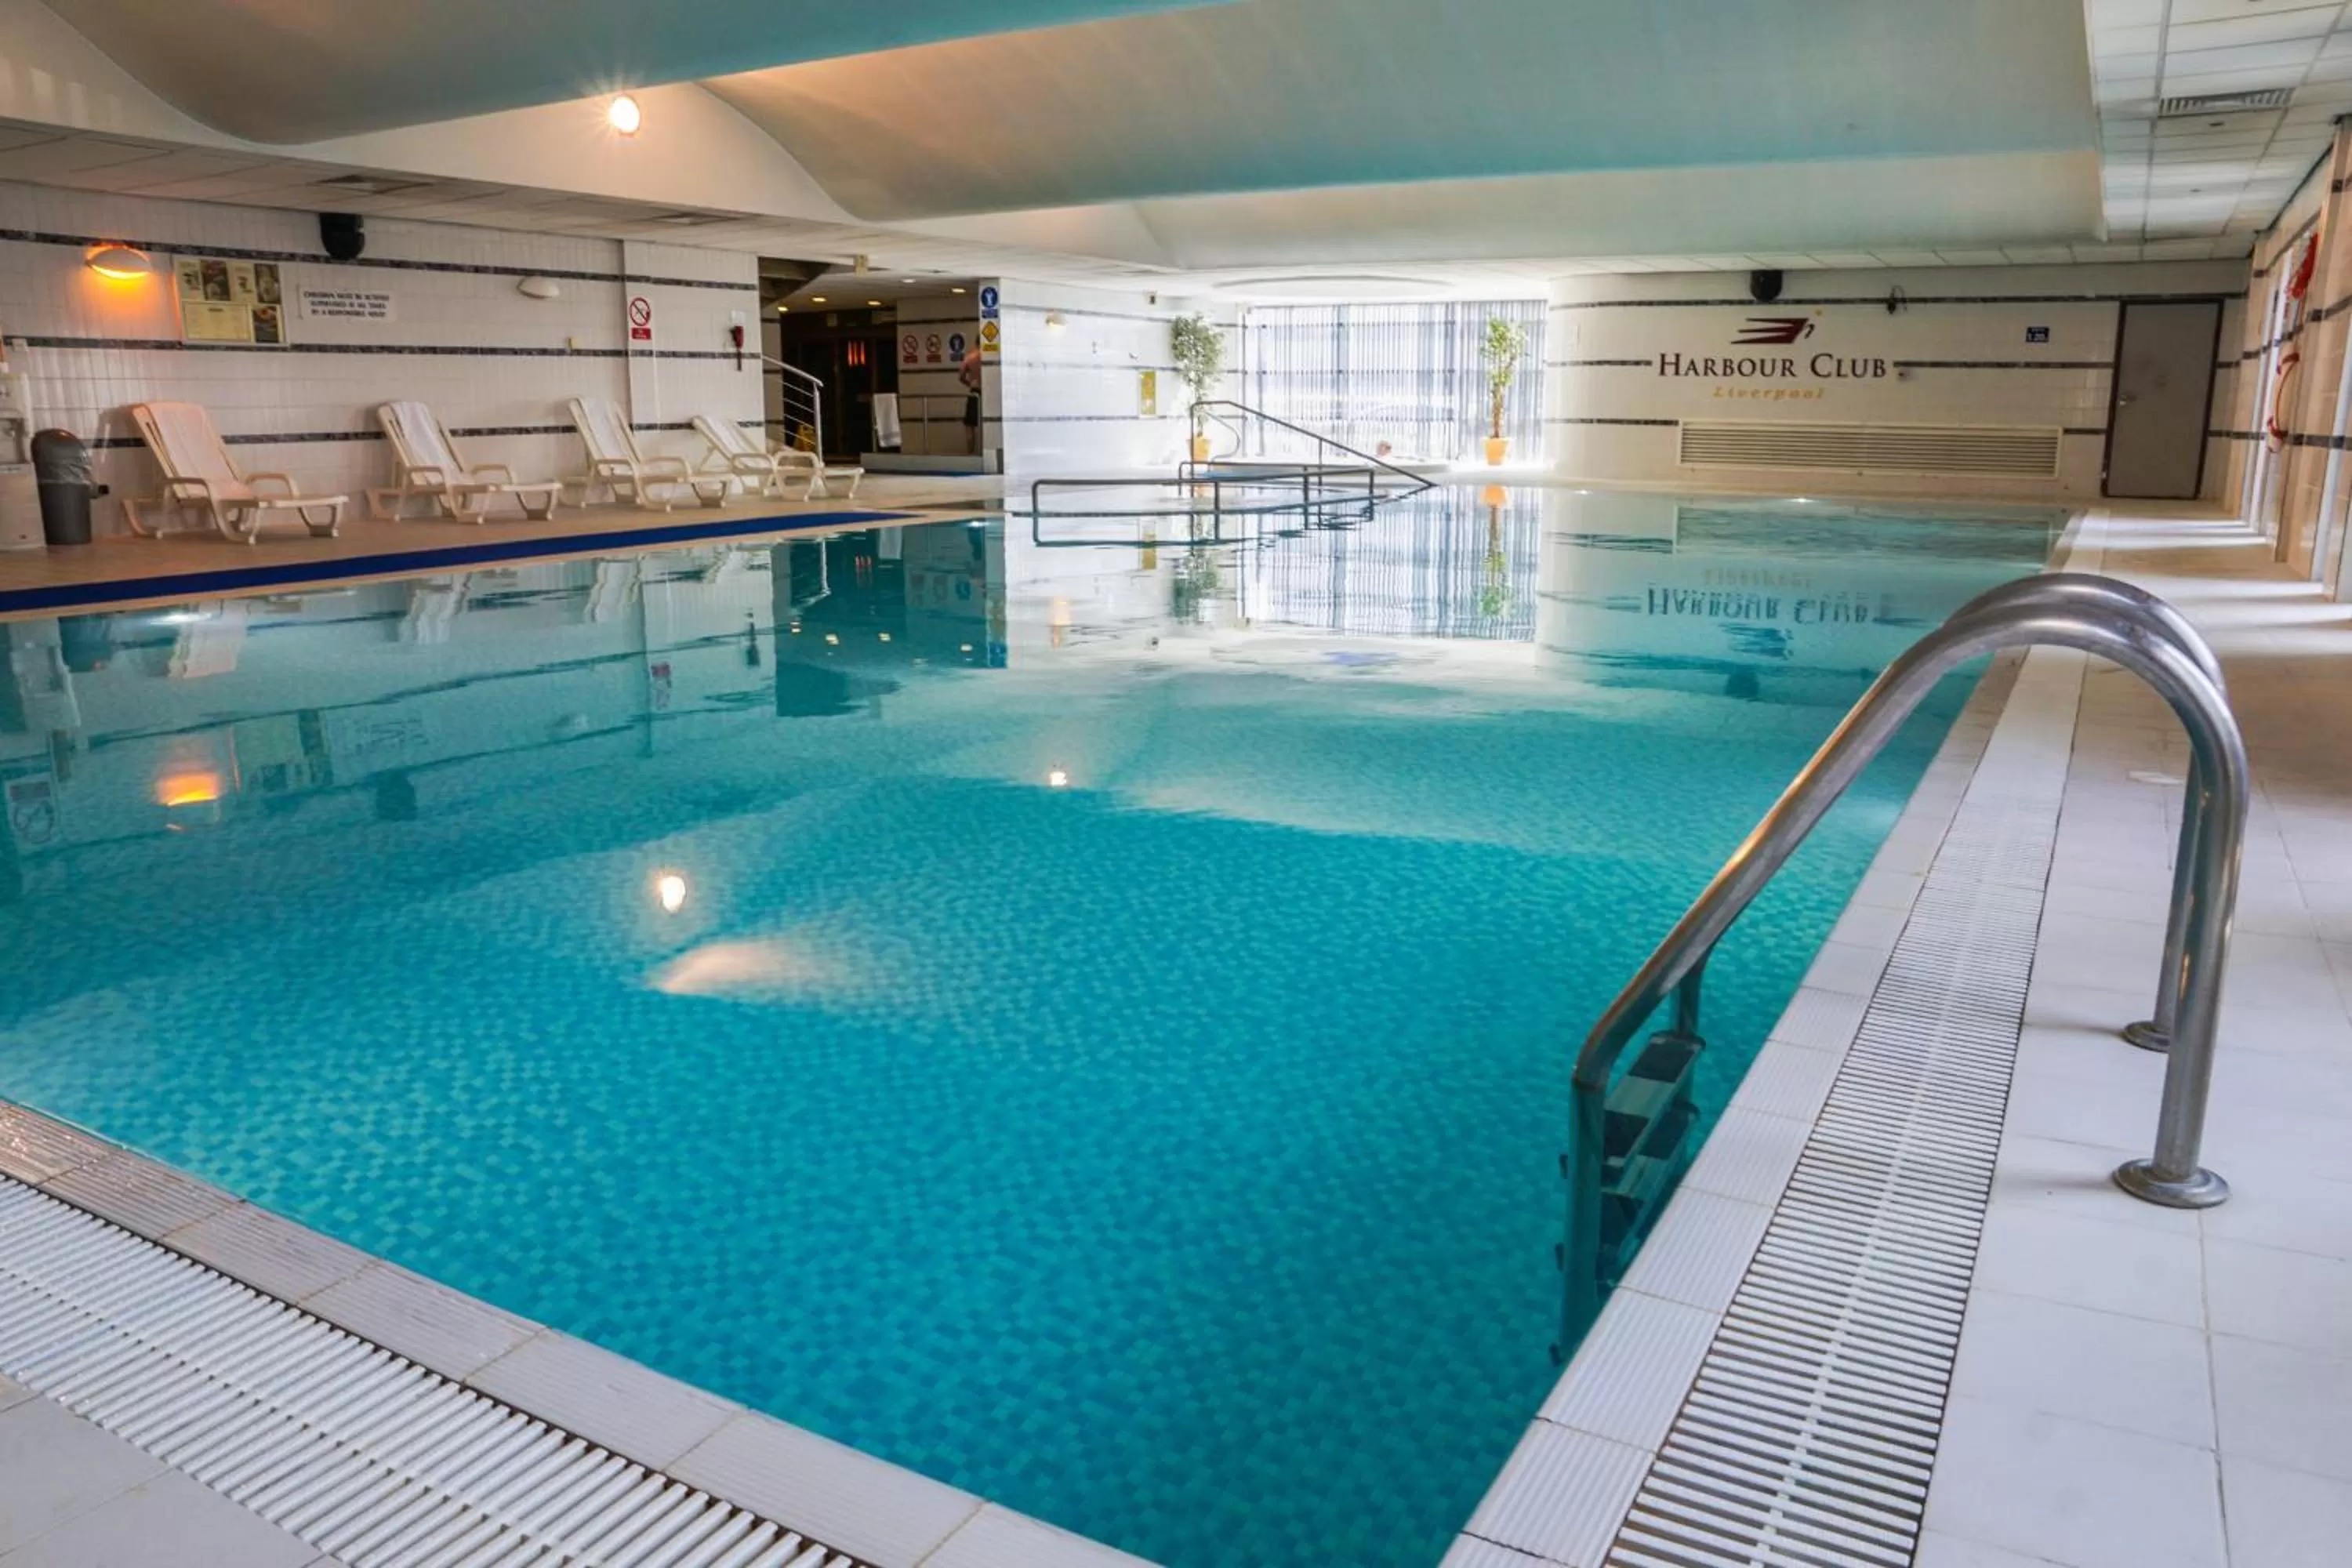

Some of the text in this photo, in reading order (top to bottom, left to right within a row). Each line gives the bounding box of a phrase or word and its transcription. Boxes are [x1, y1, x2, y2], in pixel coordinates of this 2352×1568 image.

[1658, 352, 1887, 379] HARBOUR CLUB
[1712, 385, 1825, 401] Liverpool
